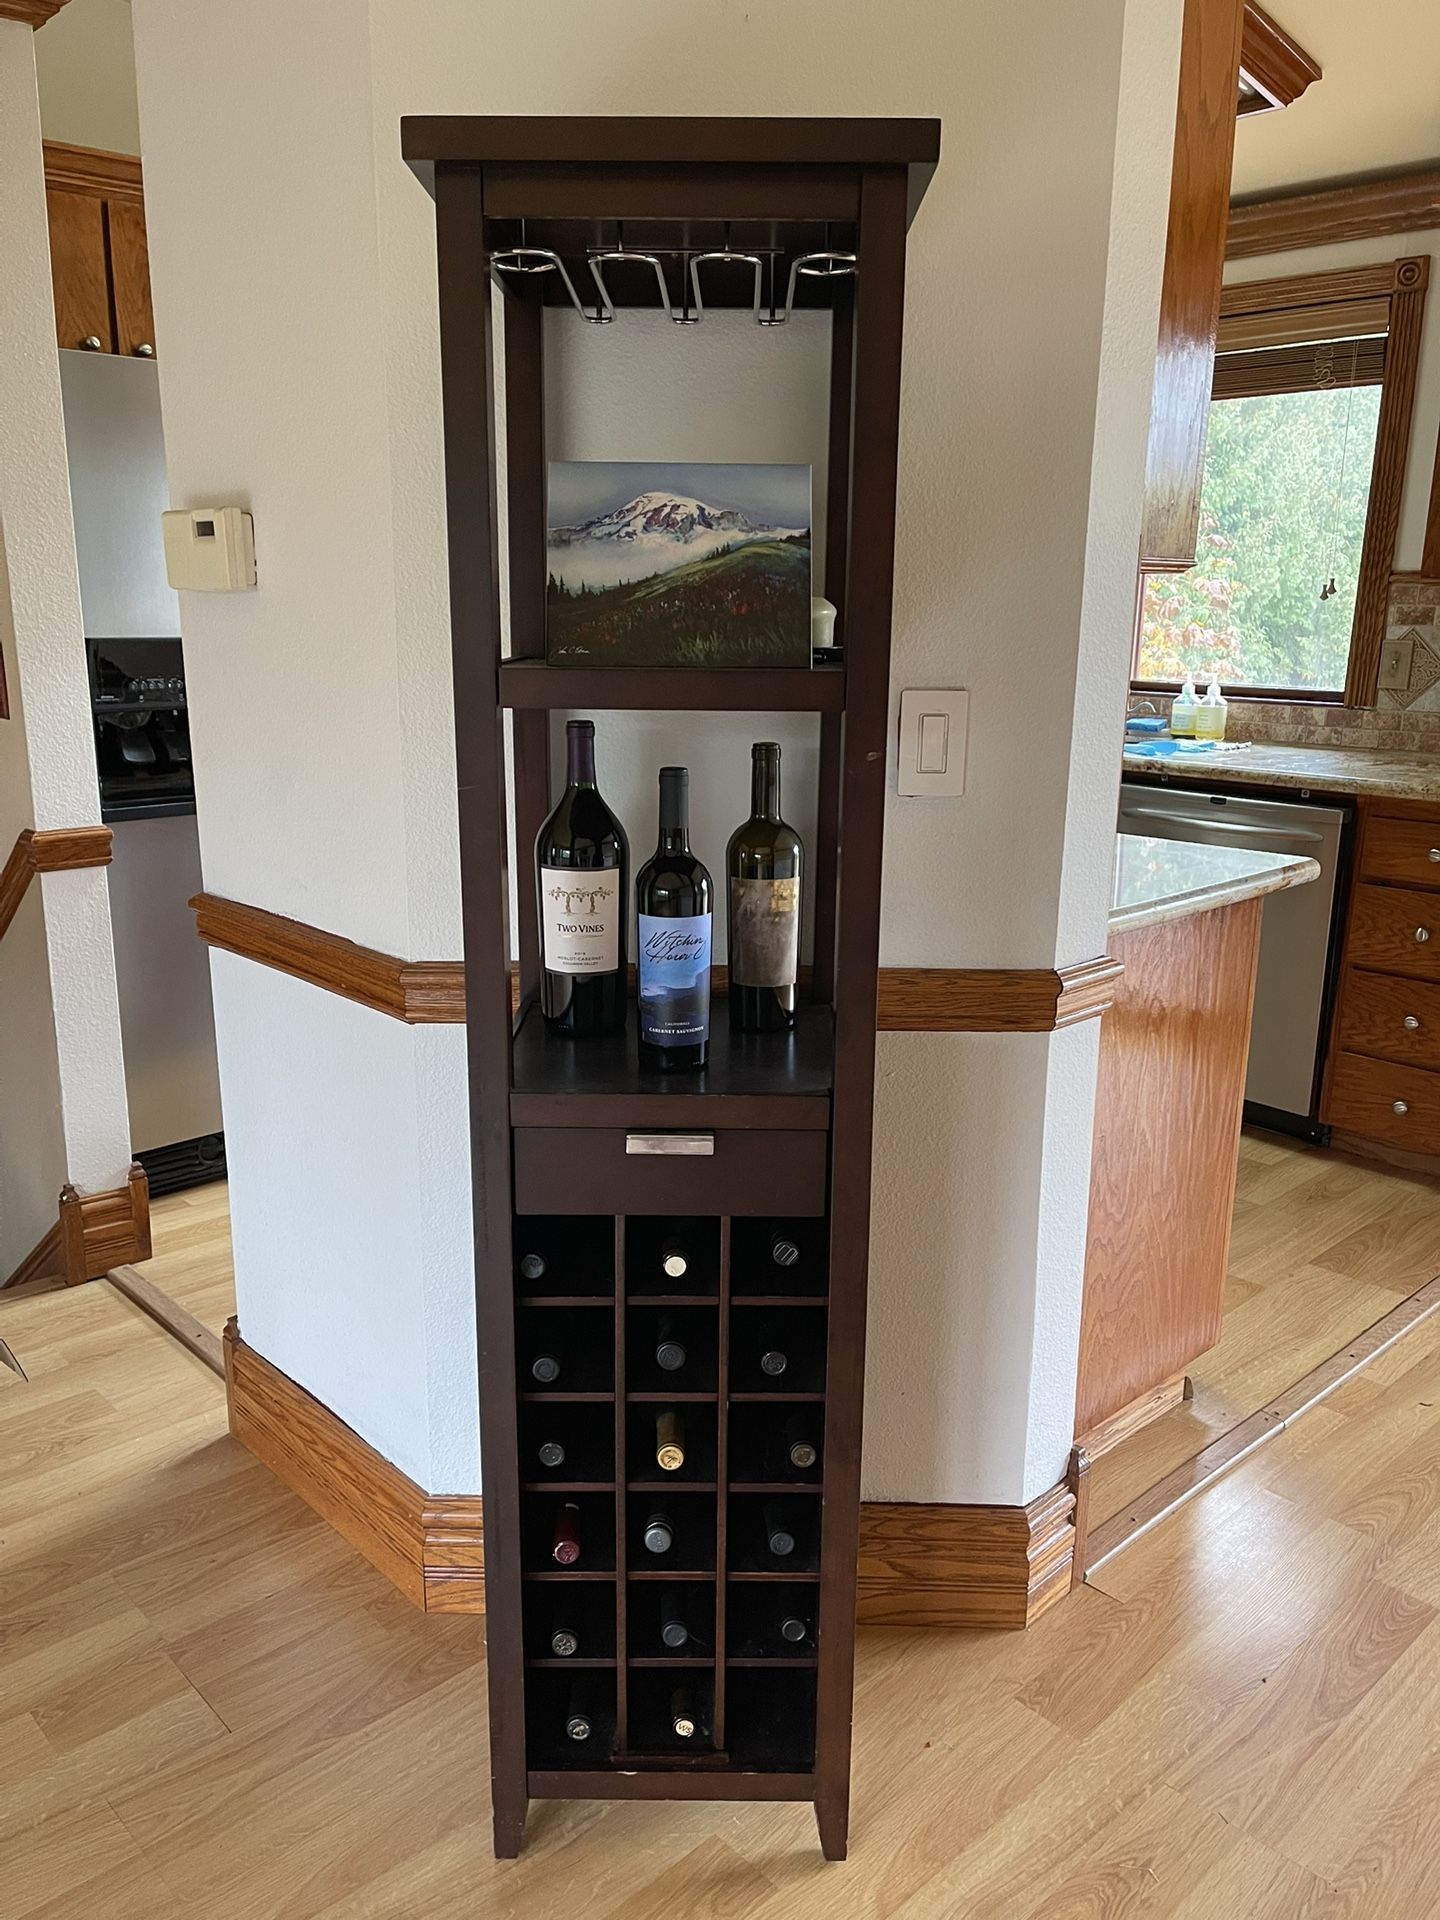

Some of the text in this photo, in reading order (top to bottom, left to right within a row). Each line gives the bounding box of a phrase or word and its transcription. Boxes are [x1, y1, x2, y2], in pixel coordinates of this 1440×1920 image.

[556, 923, 604, 933] TWO VINES
[645, 945, 693, 964] Hour
[648, 1025, 704, 1034] CABERNET SAUVIGNON
